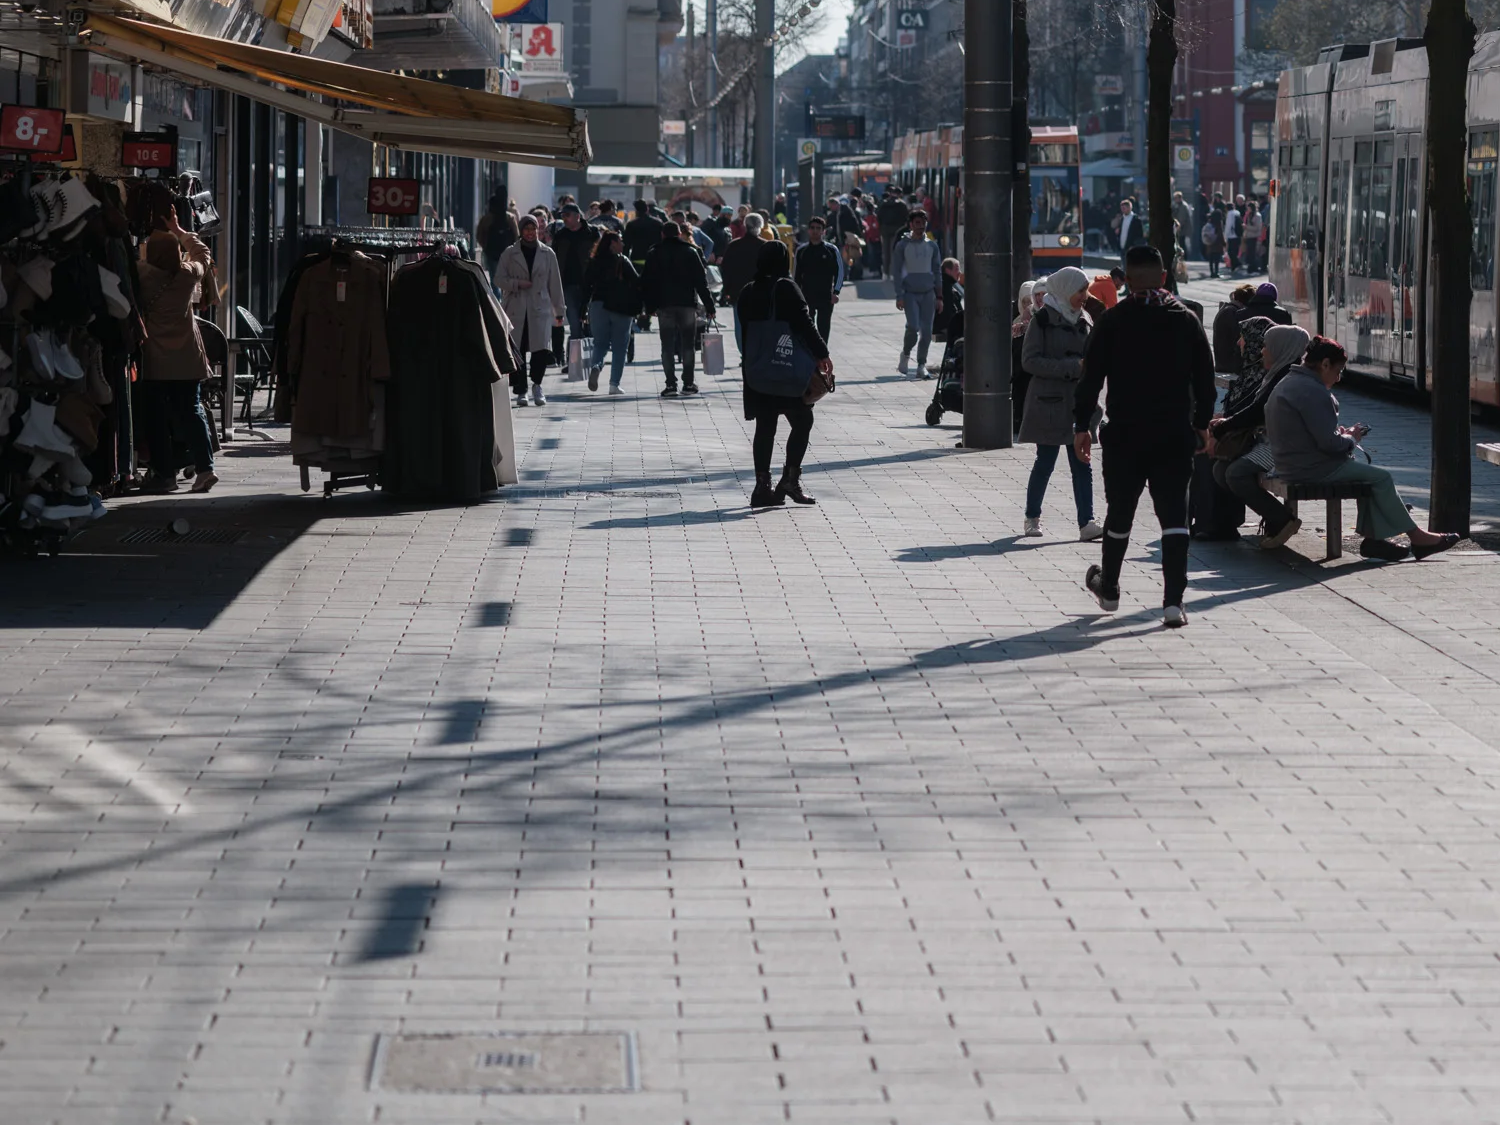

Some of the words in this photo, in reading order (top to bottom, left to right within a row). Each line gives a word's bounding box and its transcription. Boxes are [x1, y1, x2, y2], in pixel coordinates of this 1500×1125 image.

[136, 149, 150, 161] 10
[151, 149, 160, 161] €
[775, 346, 794, 356] ALDI
